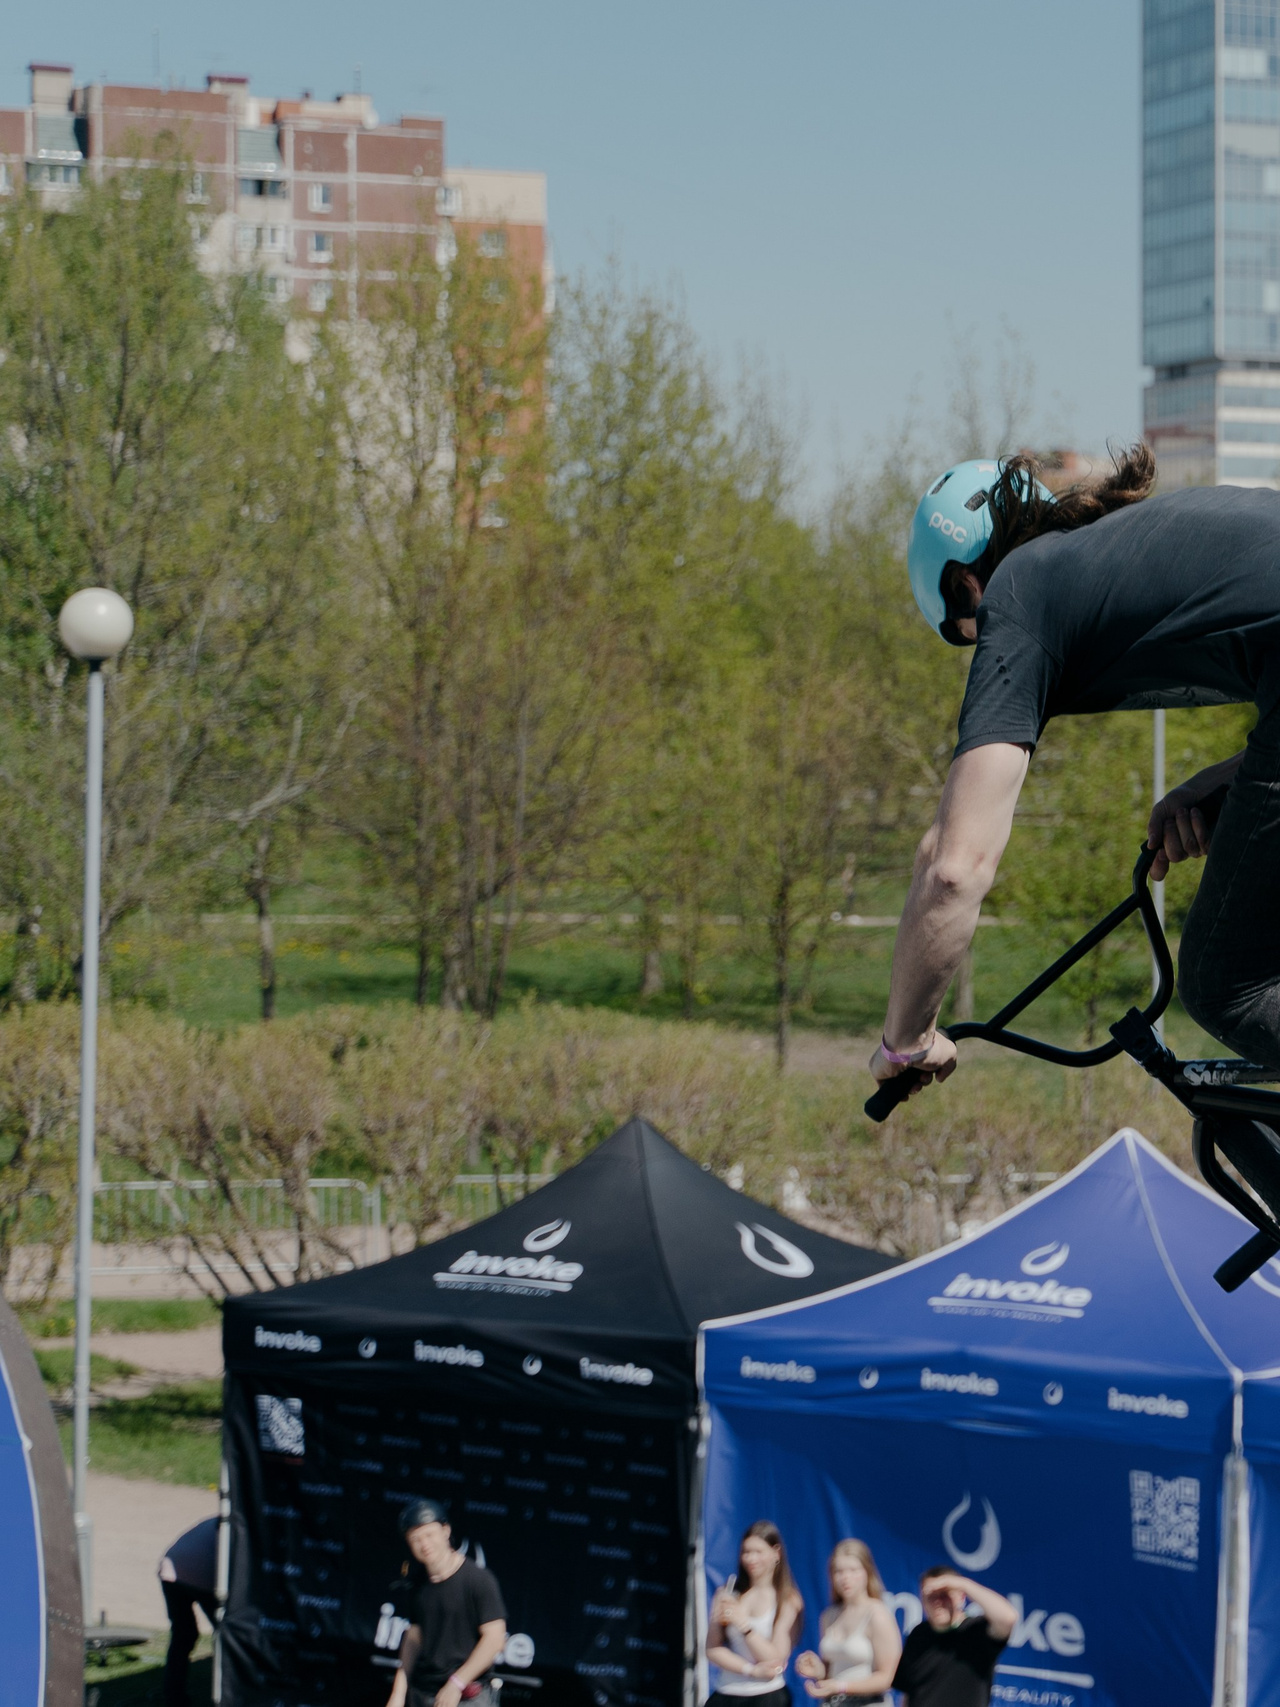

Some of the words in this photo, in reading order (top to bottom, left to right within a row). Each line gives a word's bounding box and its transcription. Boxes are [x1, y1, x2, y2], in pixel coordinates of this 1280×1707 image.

[928, 511, 968, 545] poc
[448, 1250, 584, 1282] invoke
[942, 1273, 1093, 1308] invoke
[254, 1325, 322, 1353] invoke
[414, 1339, 485, 1368] invoke
[579, 1356, 654, 1386] invoke
[740, 1355, 817, 1384] invoke
[920, 1367, 999, 1397] invoke
[1107, 1386, 1189, 1419] invoke
[991, 1684, 1075, 1707] REALITY
